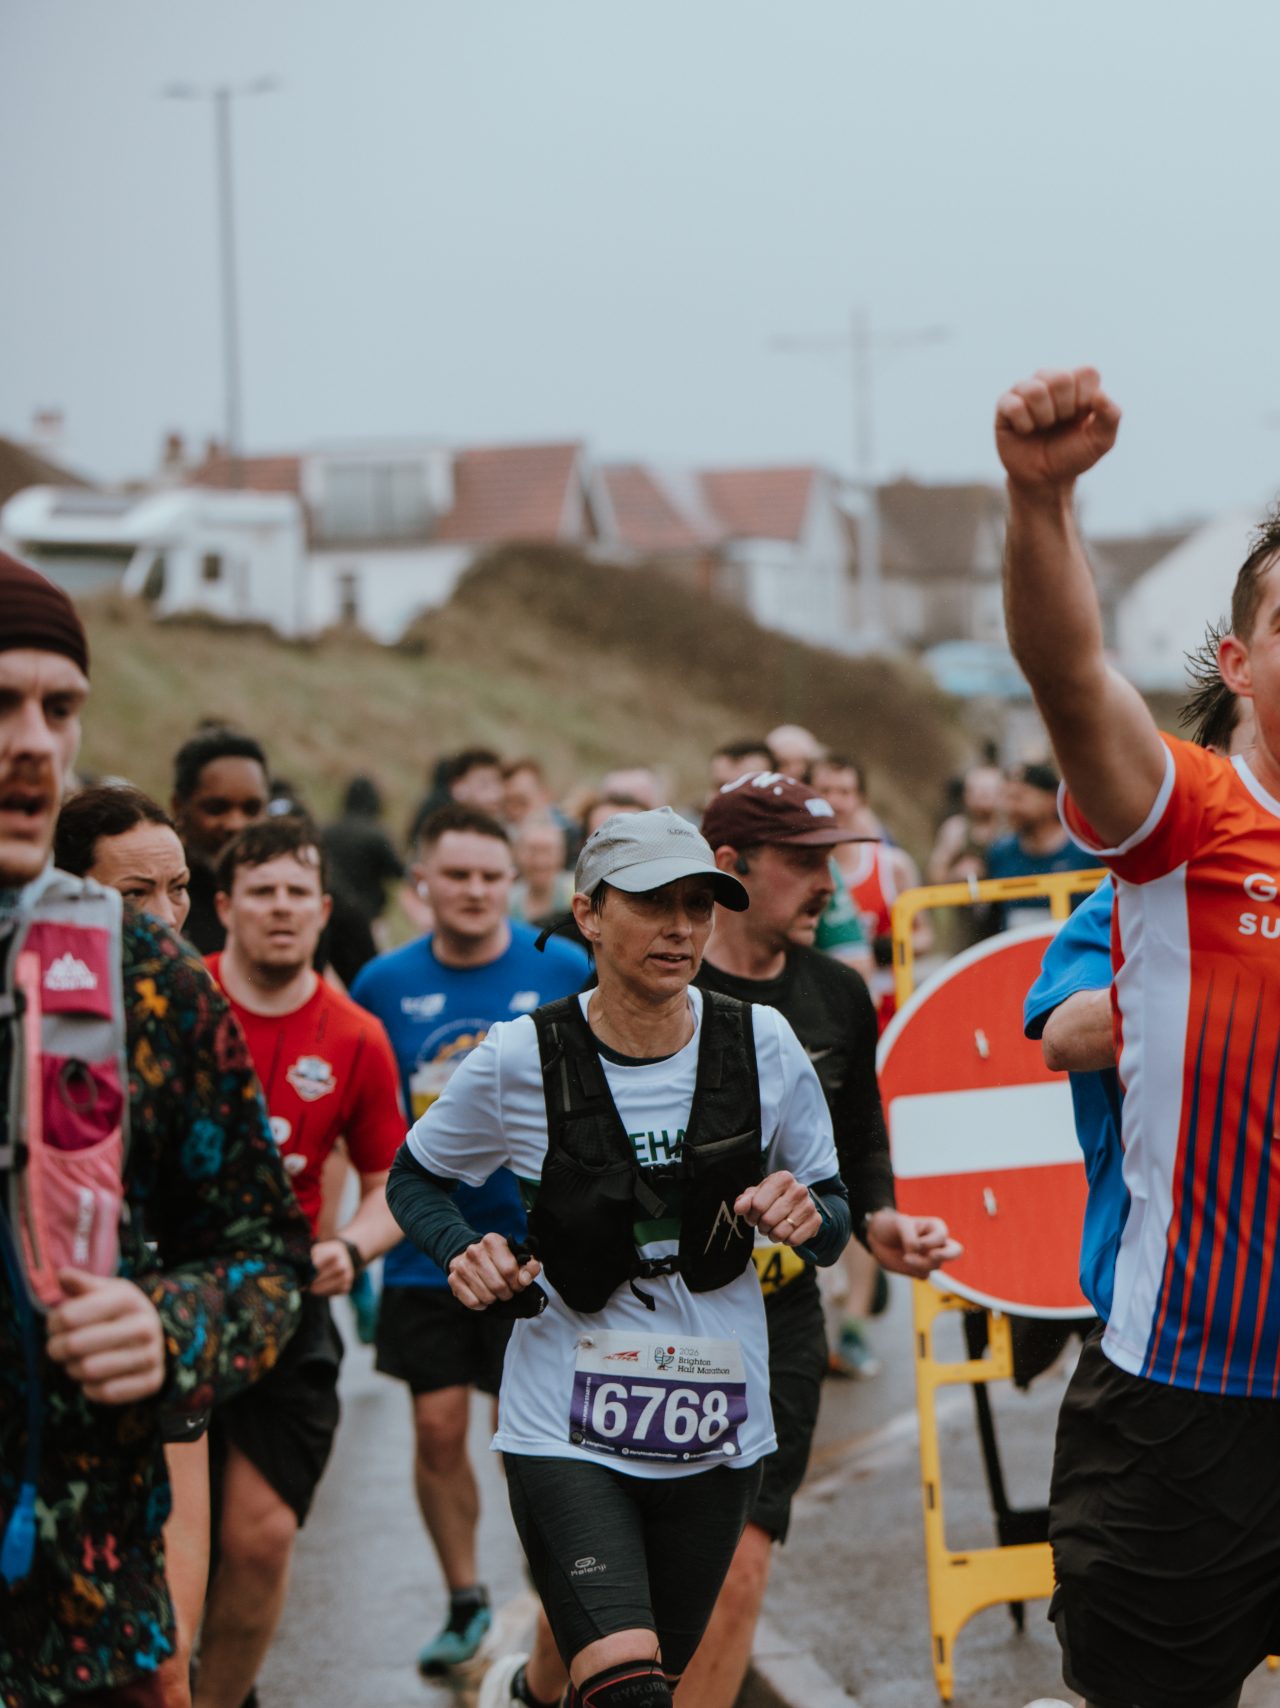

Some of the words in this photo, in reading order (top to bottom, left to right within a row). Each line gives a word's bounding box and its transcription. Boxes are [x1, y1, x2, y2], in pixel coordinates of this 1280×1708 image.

[679, 1347, 699, 1356] 2026
[679, 1356, 711, 1367] Brighton
[677, 1365, 695, 1374] Half
[697, 1366, 730, 1375] Marathon
[592, 1382, 729, 1444] 6768
